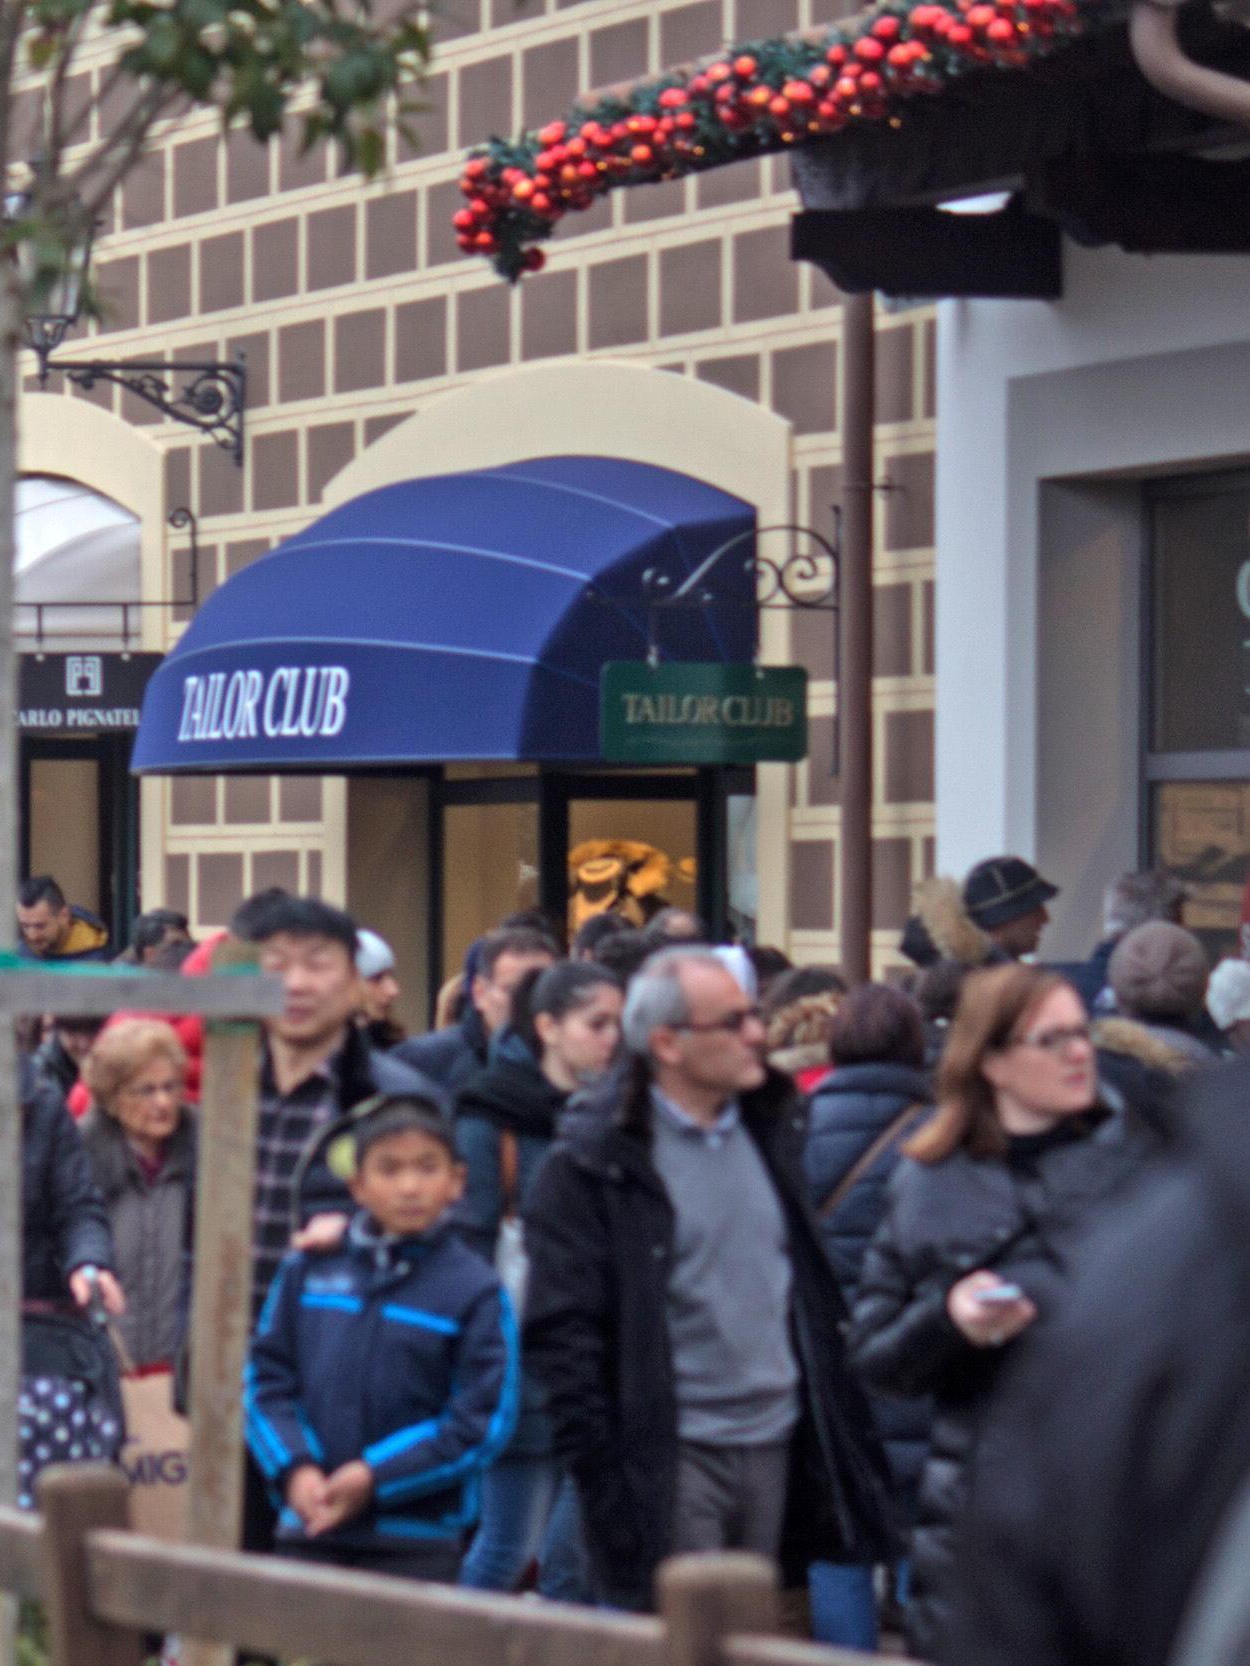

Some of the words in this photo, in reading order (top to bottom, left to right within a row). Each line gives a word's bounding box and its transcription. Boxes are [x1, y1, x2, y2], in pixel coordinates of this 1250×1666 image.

[177, 669, 263, 742] TAILOR
[263, 666, 349, 737] CLUB
[622, 693, 720, 724] TAILOR
[721, 696, 793, 727] CLUB
